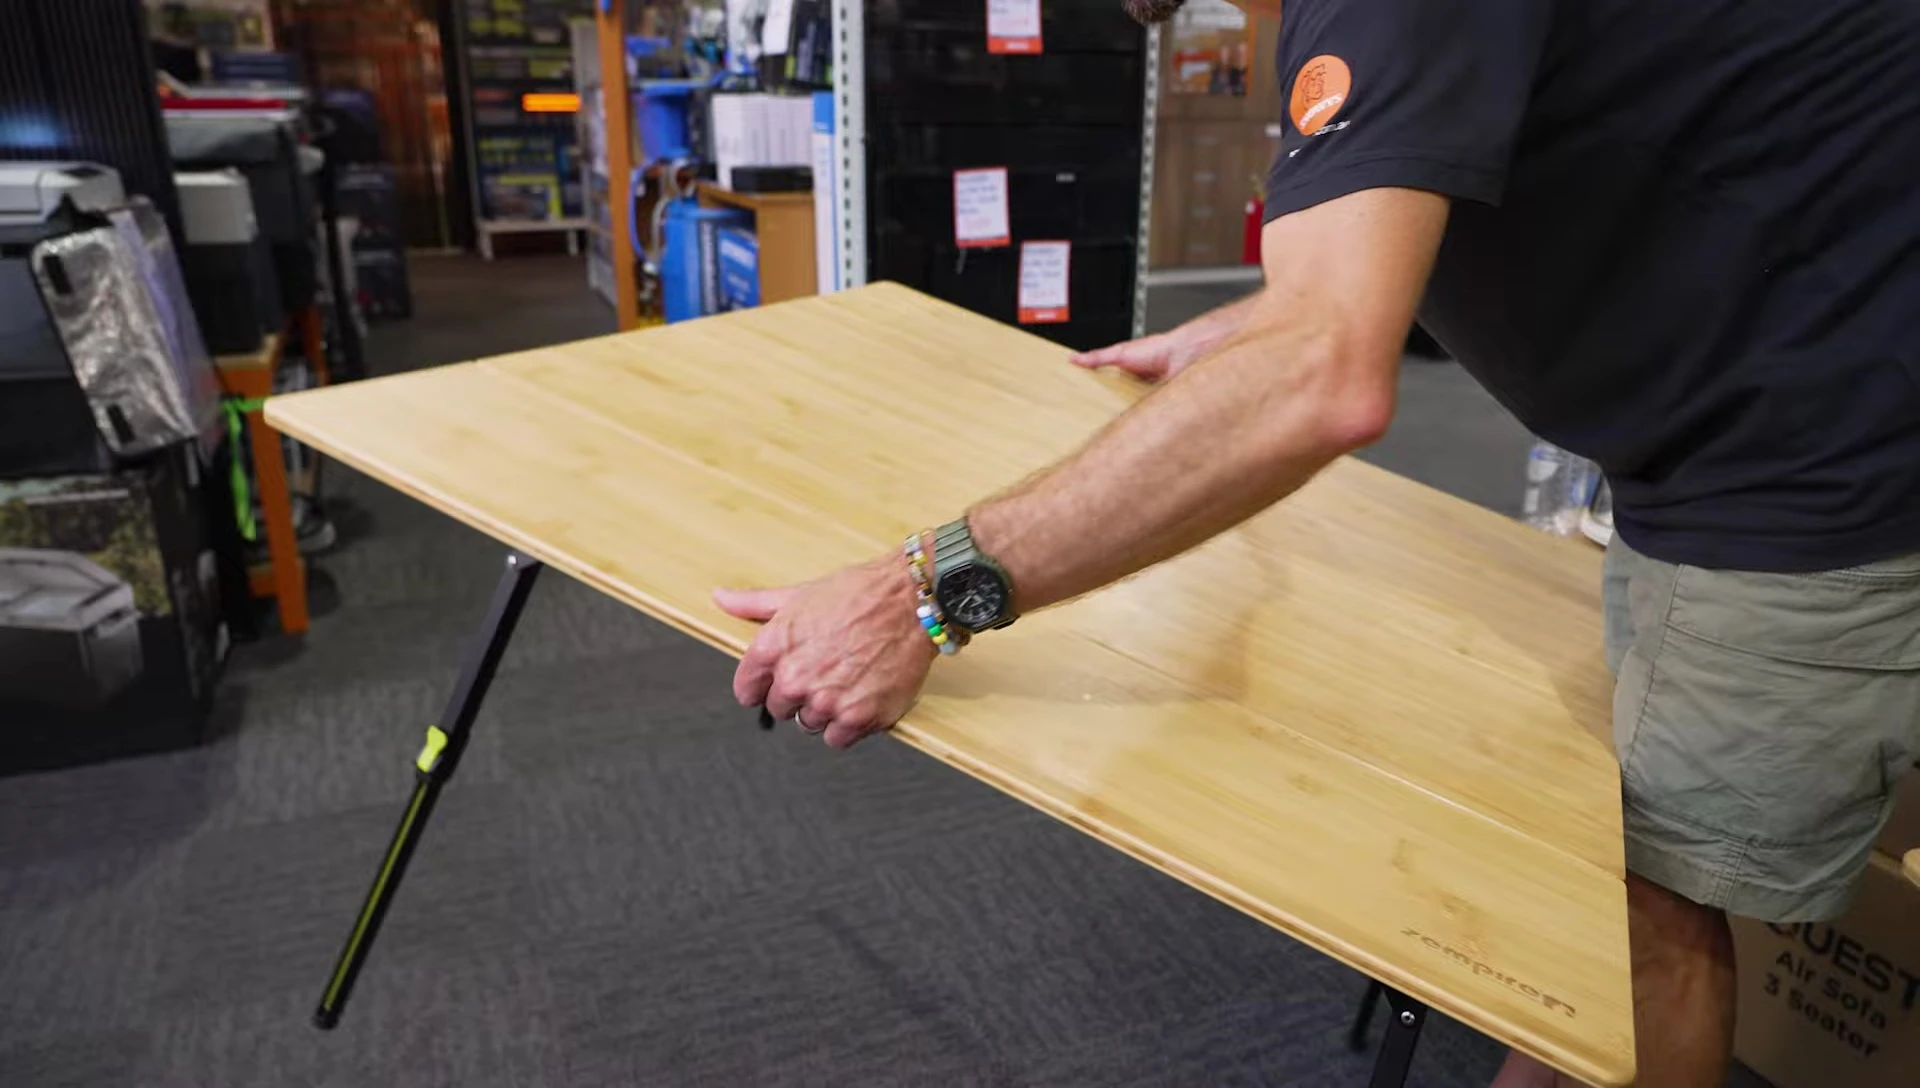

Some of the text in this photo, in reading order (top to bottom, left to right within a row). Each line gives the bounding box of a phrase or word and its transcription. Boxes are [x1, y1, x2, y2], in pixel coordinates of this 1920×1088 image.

[1764, 972, 1880, 1057] 3 Seater
[1776, 950, 1887, 1031] Air Sofa
